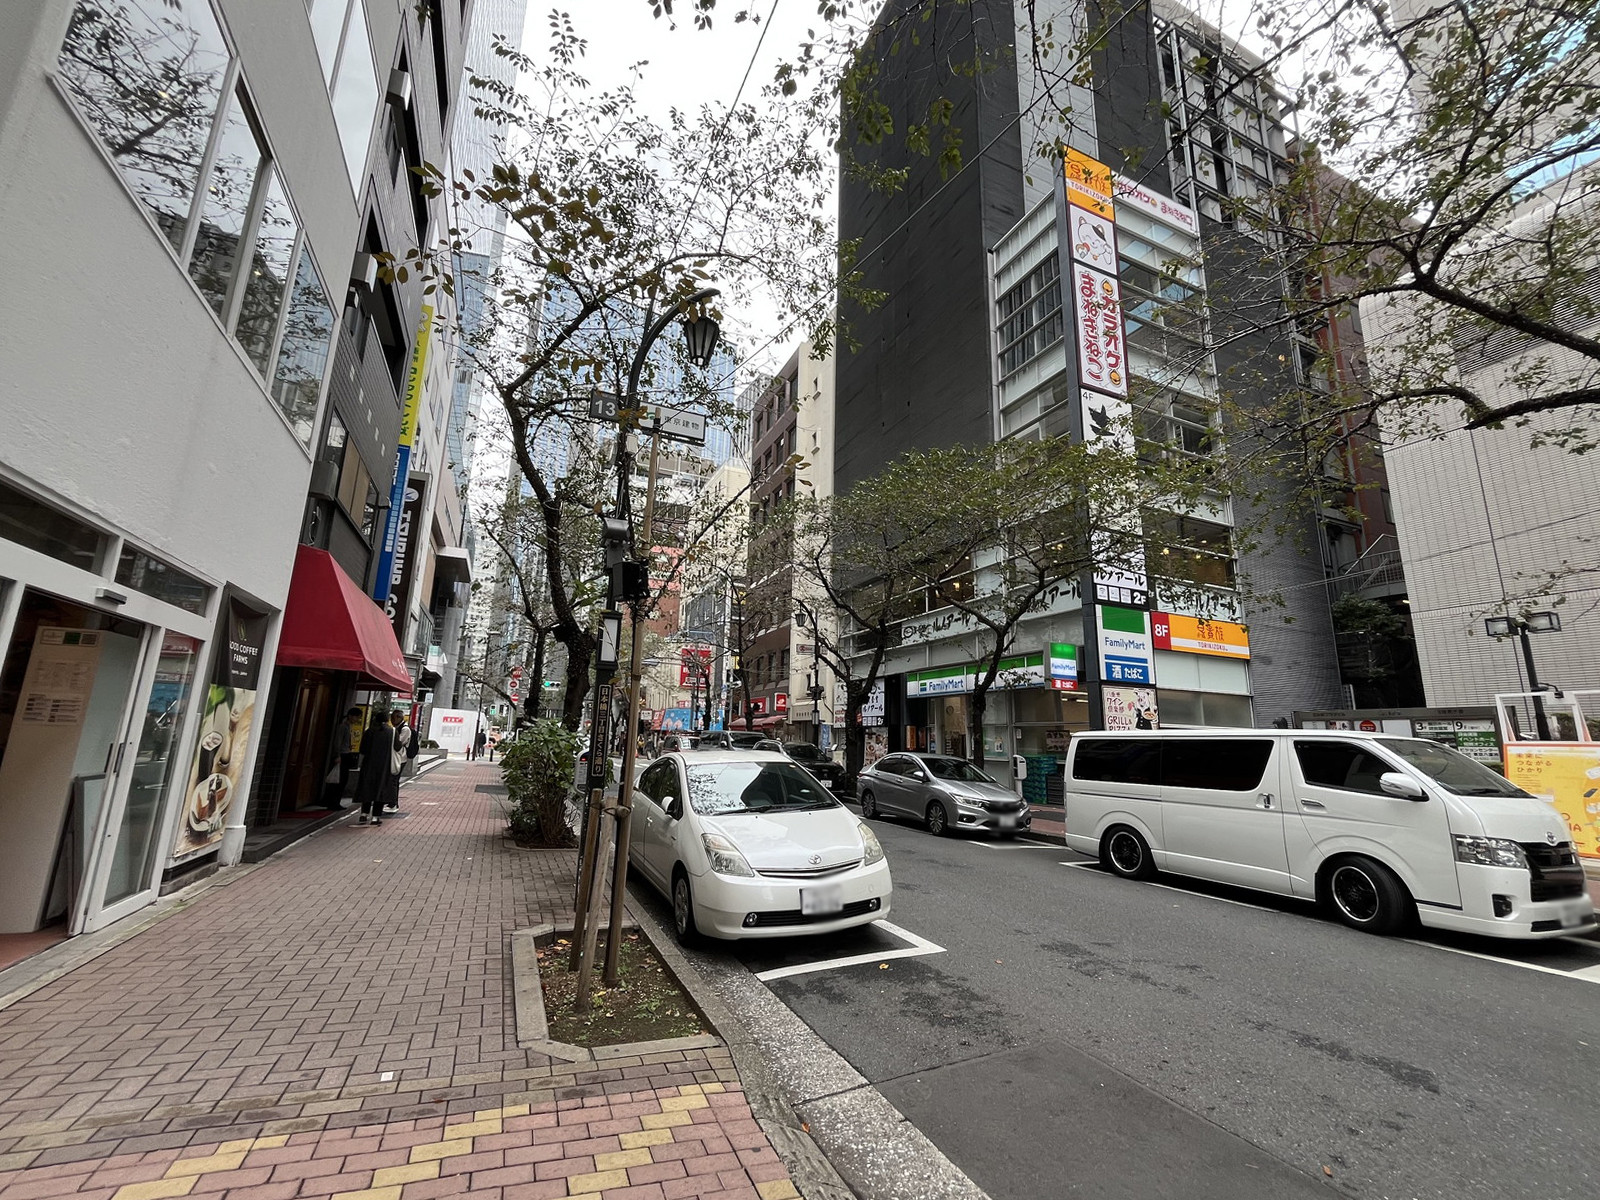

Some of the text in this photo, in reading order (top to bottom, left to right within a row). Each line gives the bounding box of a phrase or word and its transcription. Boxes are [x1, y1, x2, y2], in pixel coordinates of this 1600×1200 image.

[1080, 272, 1103, 381] まねきねこ
[1101, 294, 1121, 369] カラオケ
[1082, 391, 1094, 401] 4F
[595, 400, 616, 417] 13
[1133, 591, 1147, 605] 2F
[1154, 623, 1169, 638] 8F
[1104, 637, 1146, 651] FamilyMart
[233, 653, 248, 665] FARMS
[1052, 662, 1076, 671] FamilyMart
[1112, 664, 1144, 680] 酒 たばこ
[928, 679, 963, 691] FamilyMart
[1106, 697, 1123, 706] ワイン
[1107, 715, 1128, 725] GRILL
